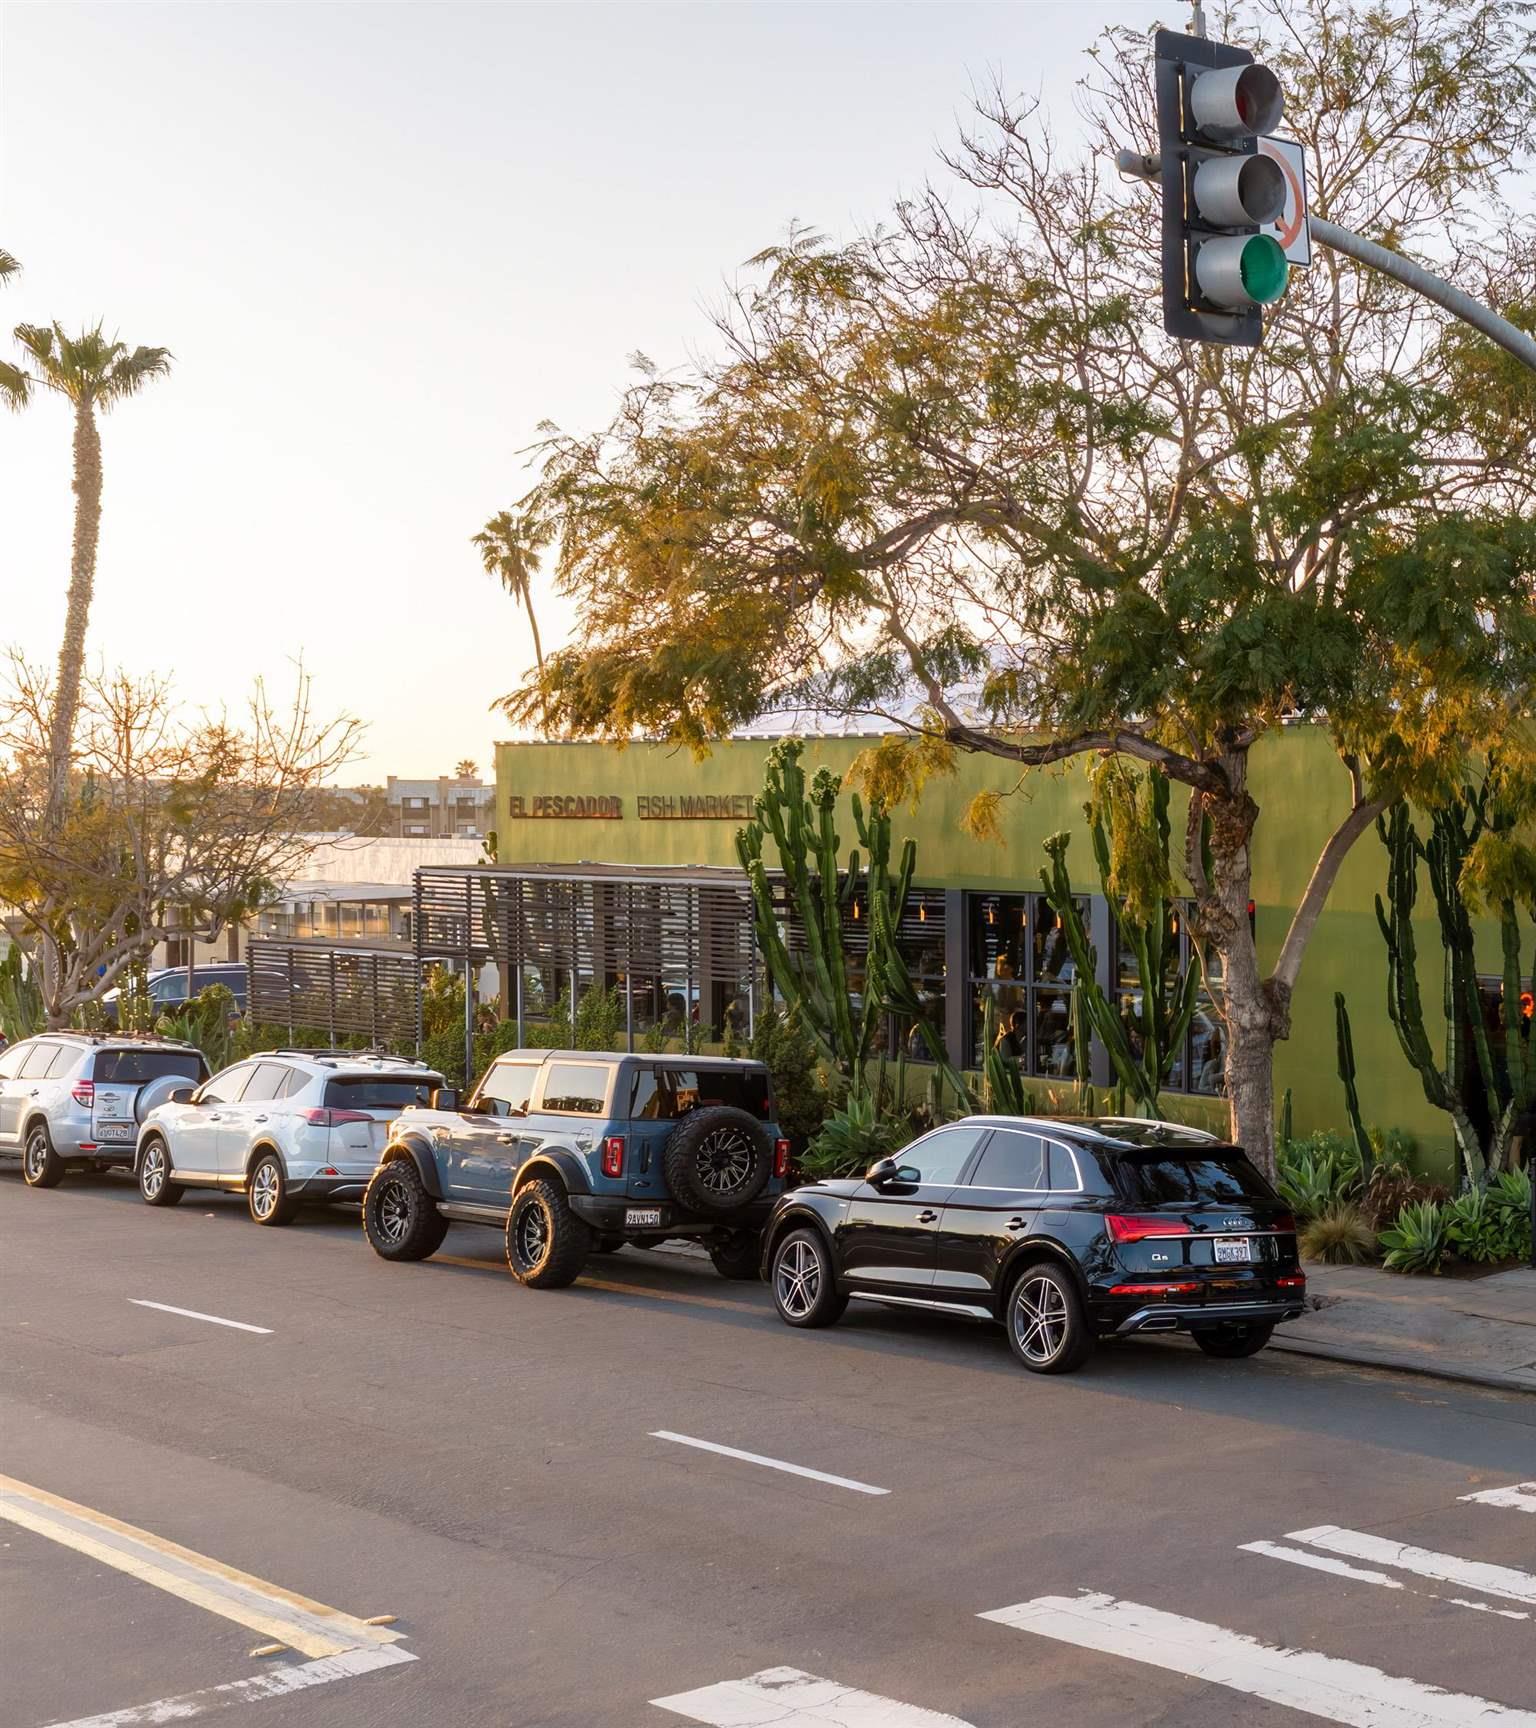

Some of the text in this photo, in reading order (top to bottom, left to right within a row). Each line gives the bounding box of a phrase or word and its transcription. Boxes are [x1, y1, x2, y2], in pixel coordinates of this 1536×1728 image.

[509, 795, 756, 818] EL PESCADOR FISH MARKET
